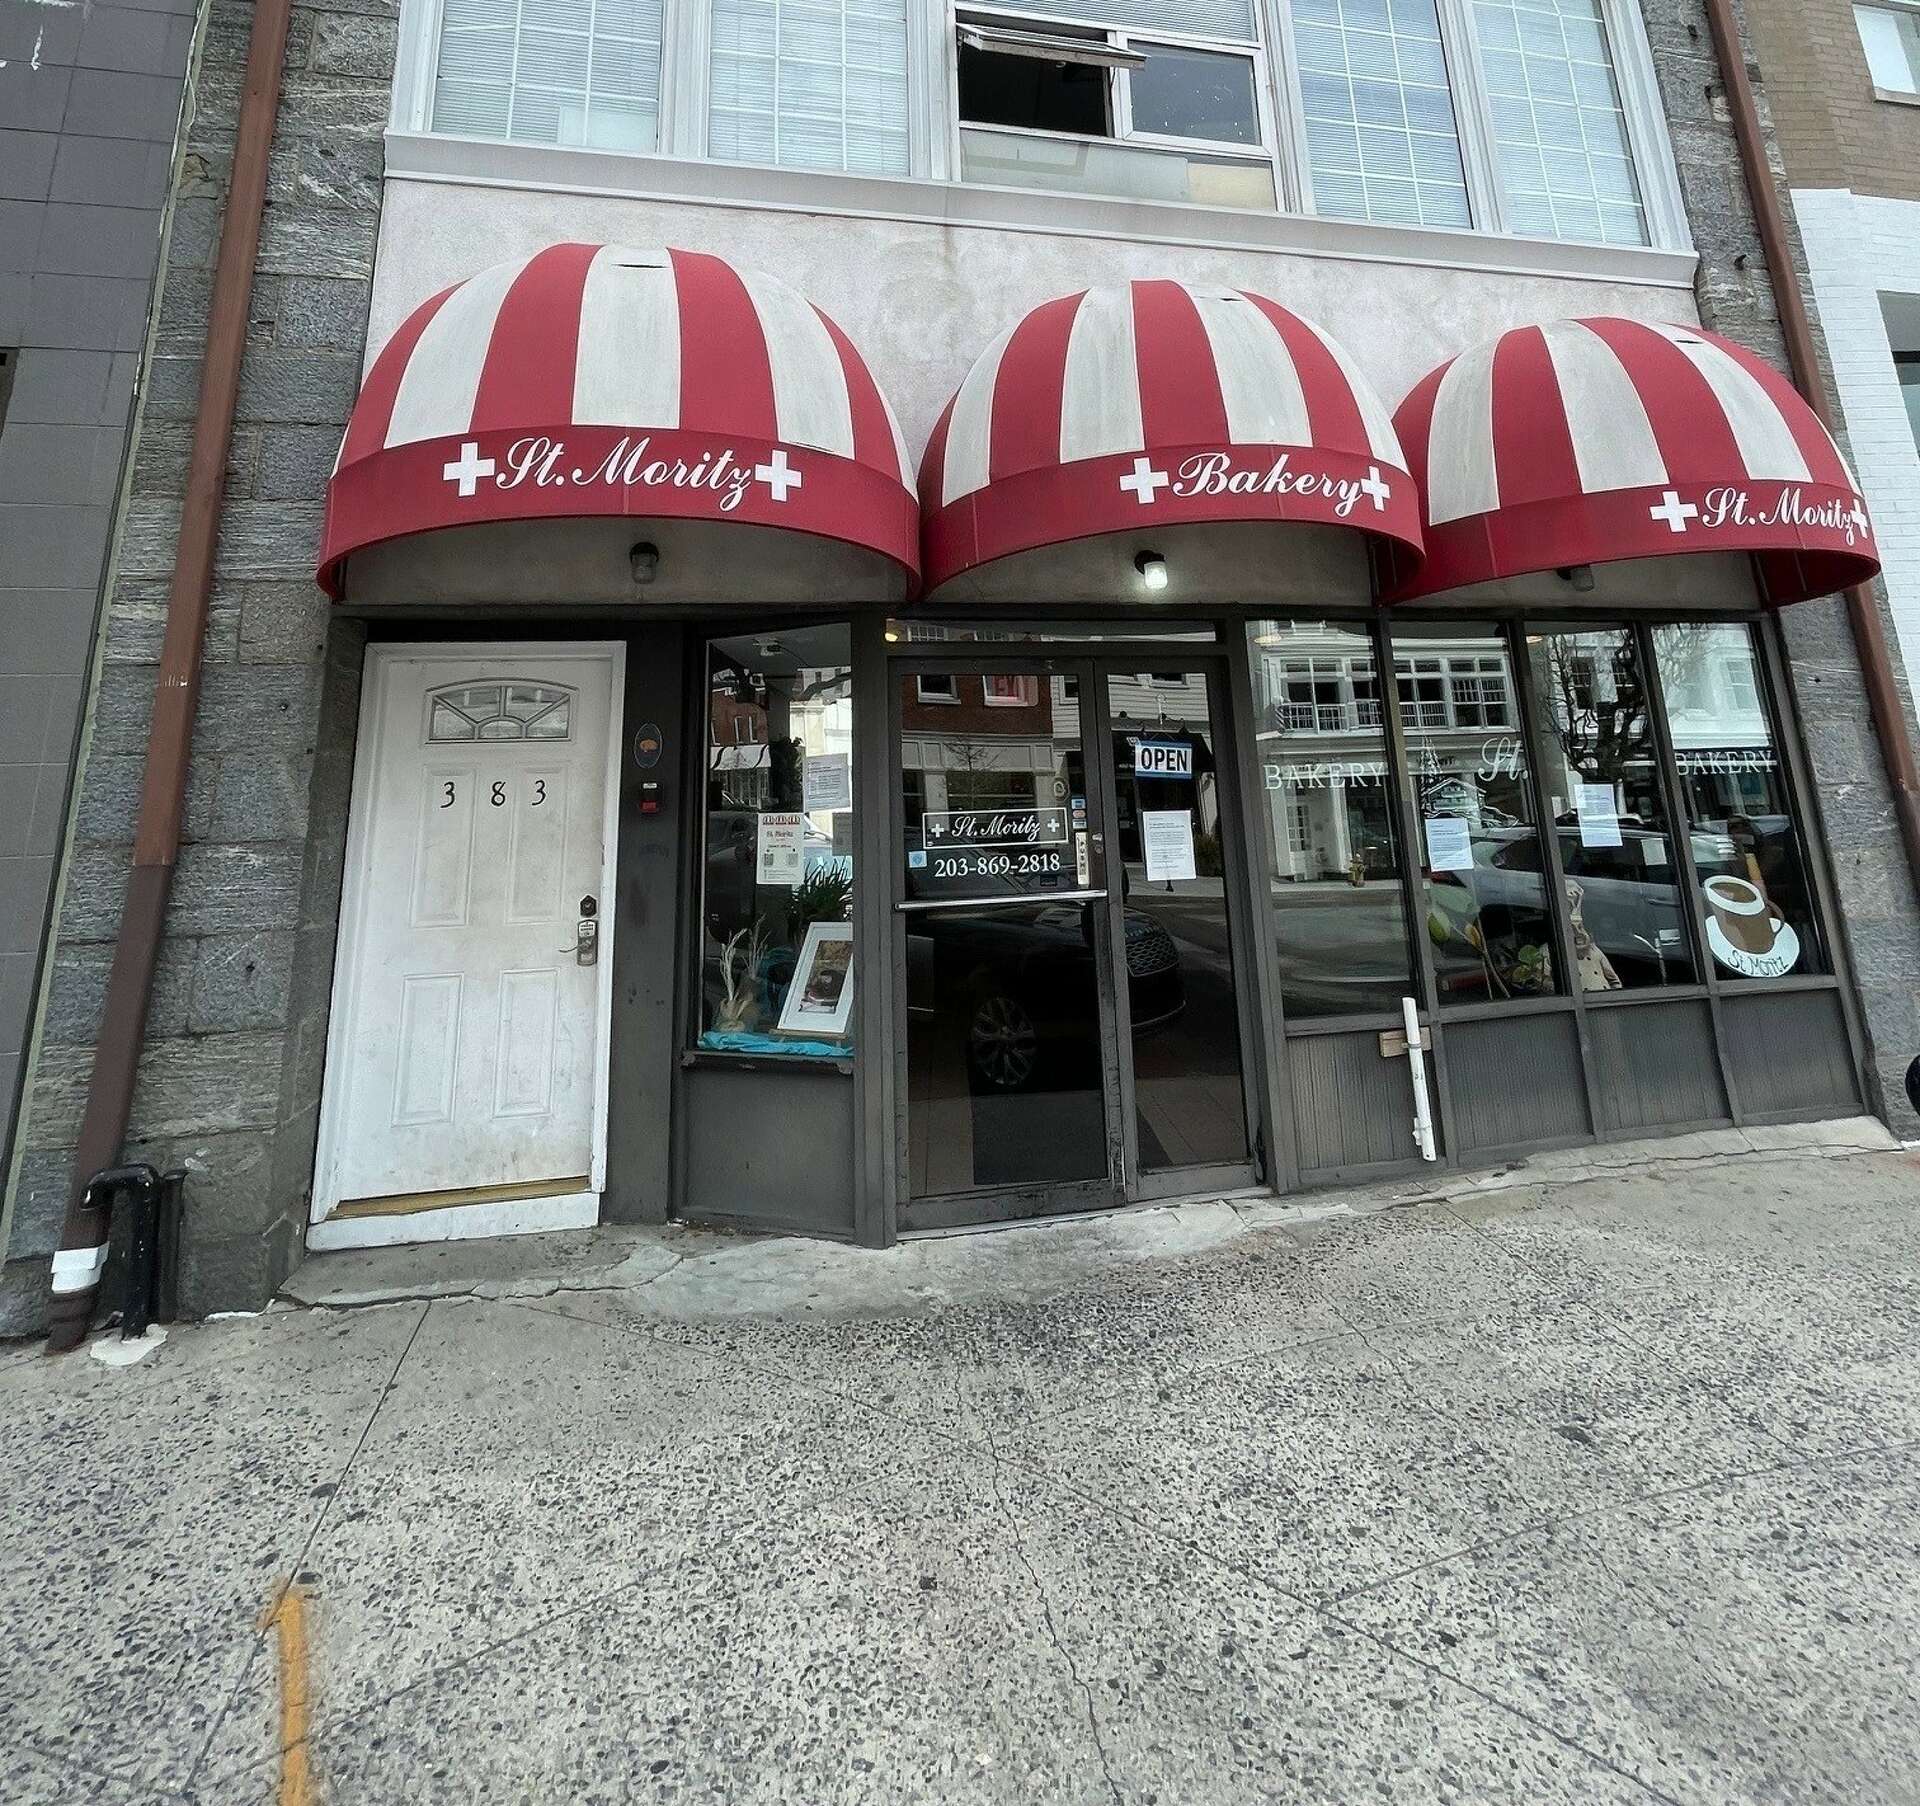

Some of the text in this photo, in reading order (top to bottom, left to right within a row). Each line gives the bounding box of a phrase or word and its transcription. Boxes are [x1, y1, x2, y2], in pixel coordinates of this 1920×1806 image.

[496, 437, 753, 511] St. Moritz
[1172, 452, 1364, 517] Bakery
[1702, 487, 1855, 545] St. Moritz
[1141, 747, 1188, 772] OPEN
[1478, 737, 1529, 782] St.
[1675, 750, 1776, 776] BAKERY
[1263, 761, 1386, 790] BAKERY
[952, 815, 1041, 841] St. Moritz
[934, 853, 1061, 878] 203-869-2818
